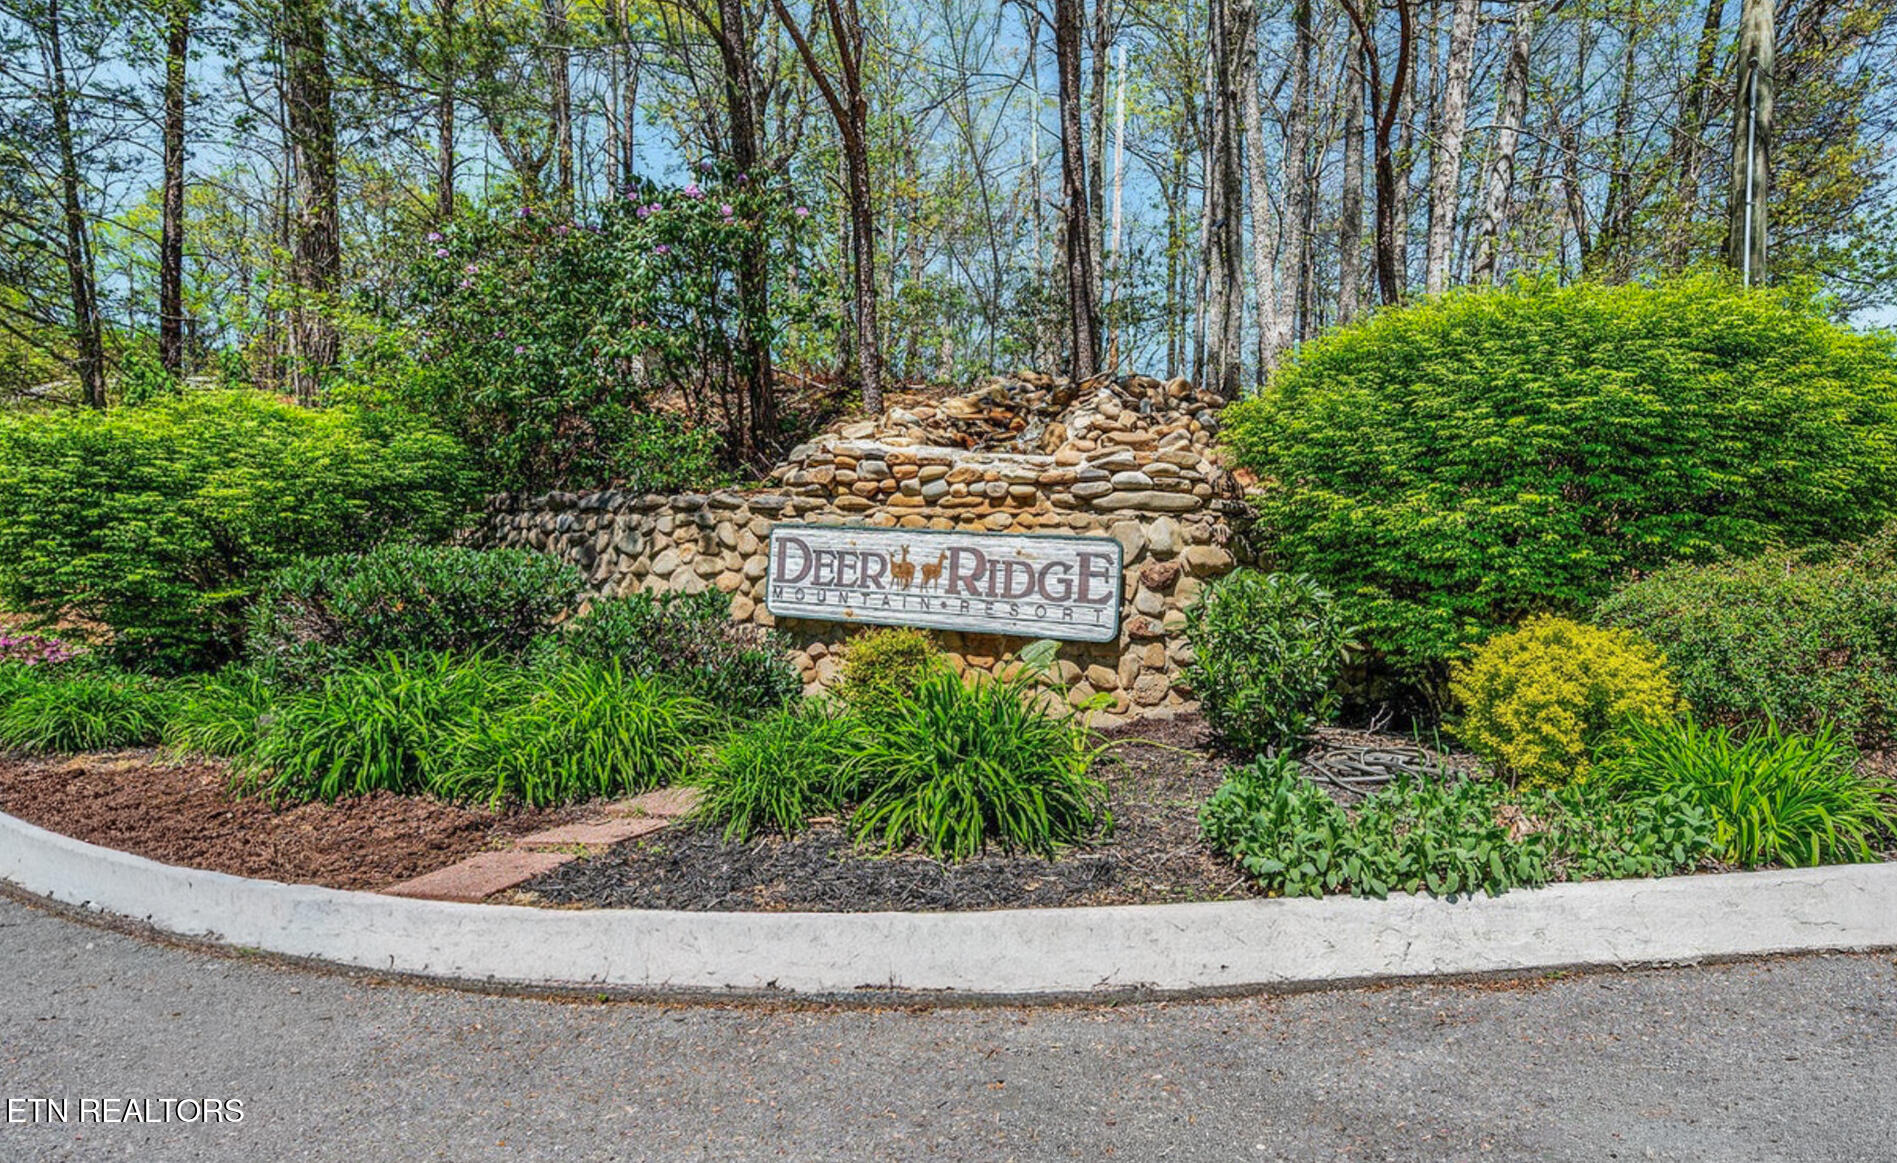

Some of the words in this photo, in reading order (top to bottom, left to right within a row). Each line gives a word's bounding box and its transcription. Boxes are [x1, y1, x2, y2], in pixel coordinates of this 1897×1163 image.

[773, 536, 888, 590] DEER
[945, 546, 1115, 604] RIDGE
[773, 587, 931, 611] MOUNTAIN
[960, 602, 1104, 623] RESORT
